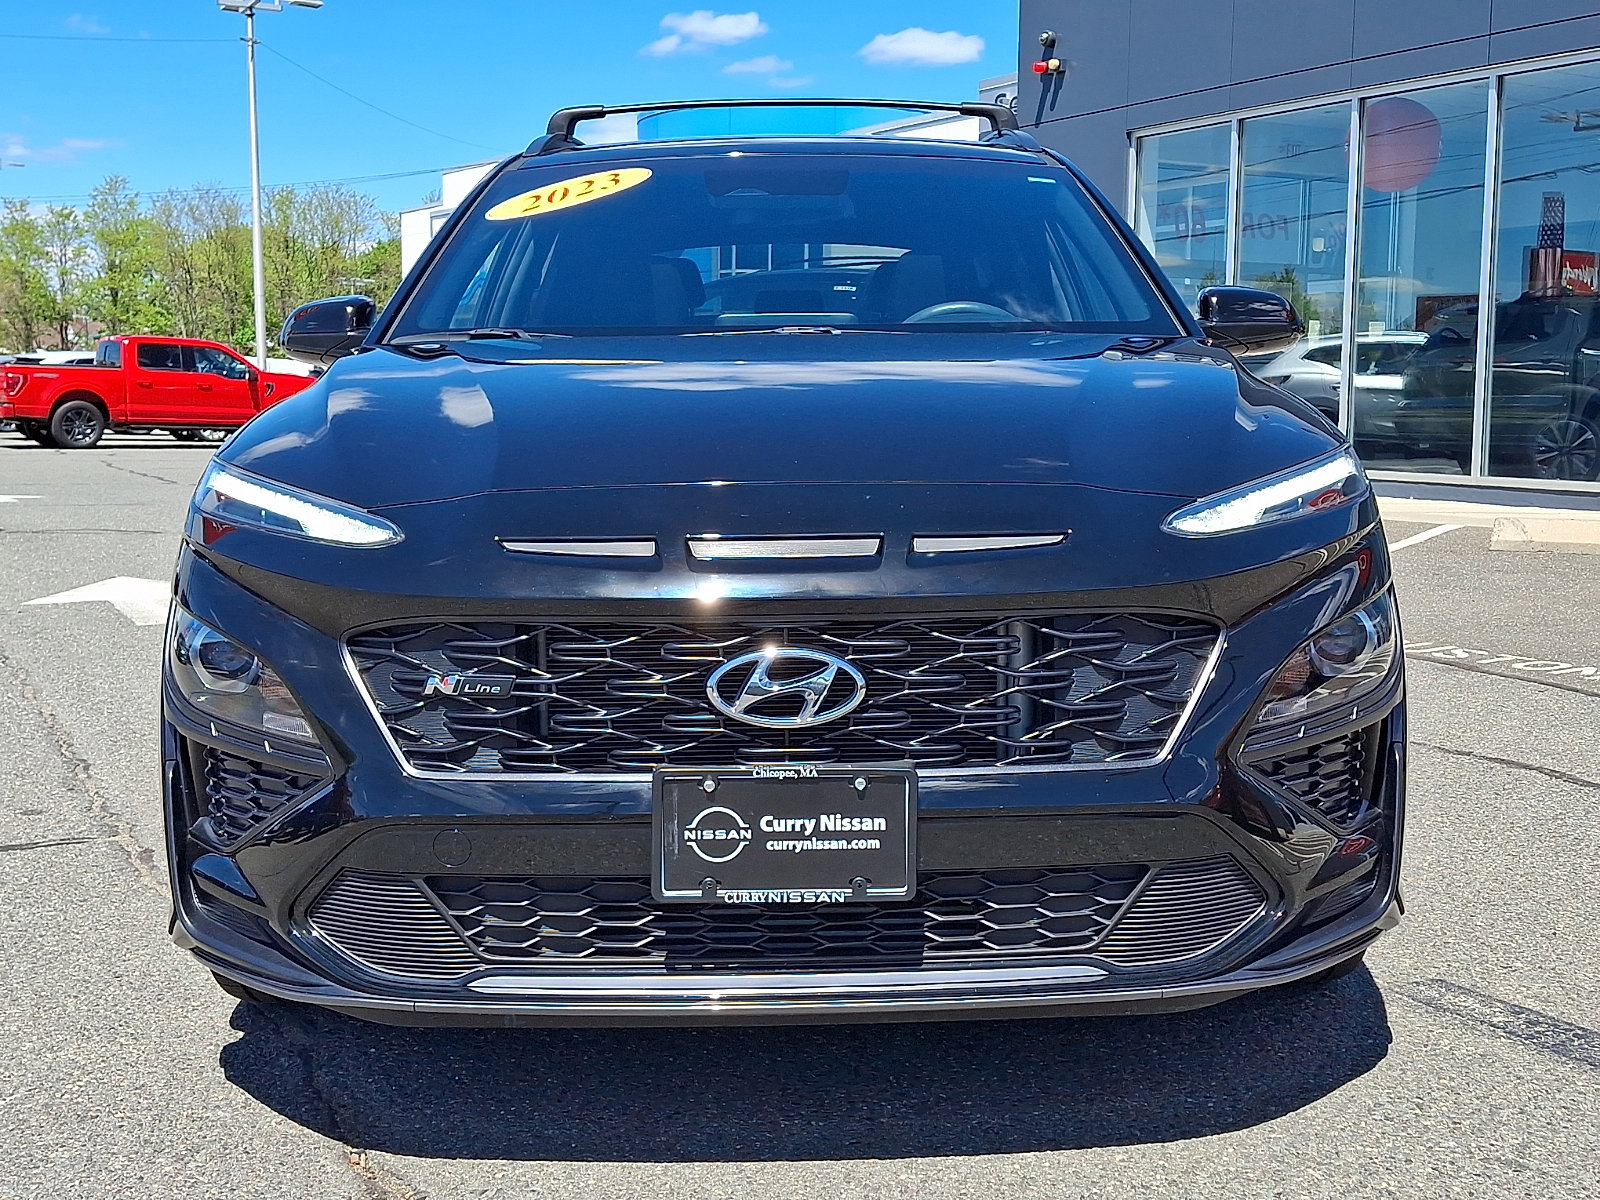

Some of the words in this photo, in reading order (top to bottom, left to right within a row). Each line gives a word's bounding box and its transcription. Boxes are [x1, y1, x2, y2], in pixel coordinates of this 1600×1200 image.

[520, 173, 621, 213] 2023
[463, 683, 501, 693] Line
[752, 766, 798, 780] Chicopee,
[800, 767, 819, 778] MA
[759, 815, 817, 836] Curry
[820, 814, 887, 832] Nissan
[684, 829, 752, 841] NISSAN
[766, 837, 881, 853] currynissan.com
